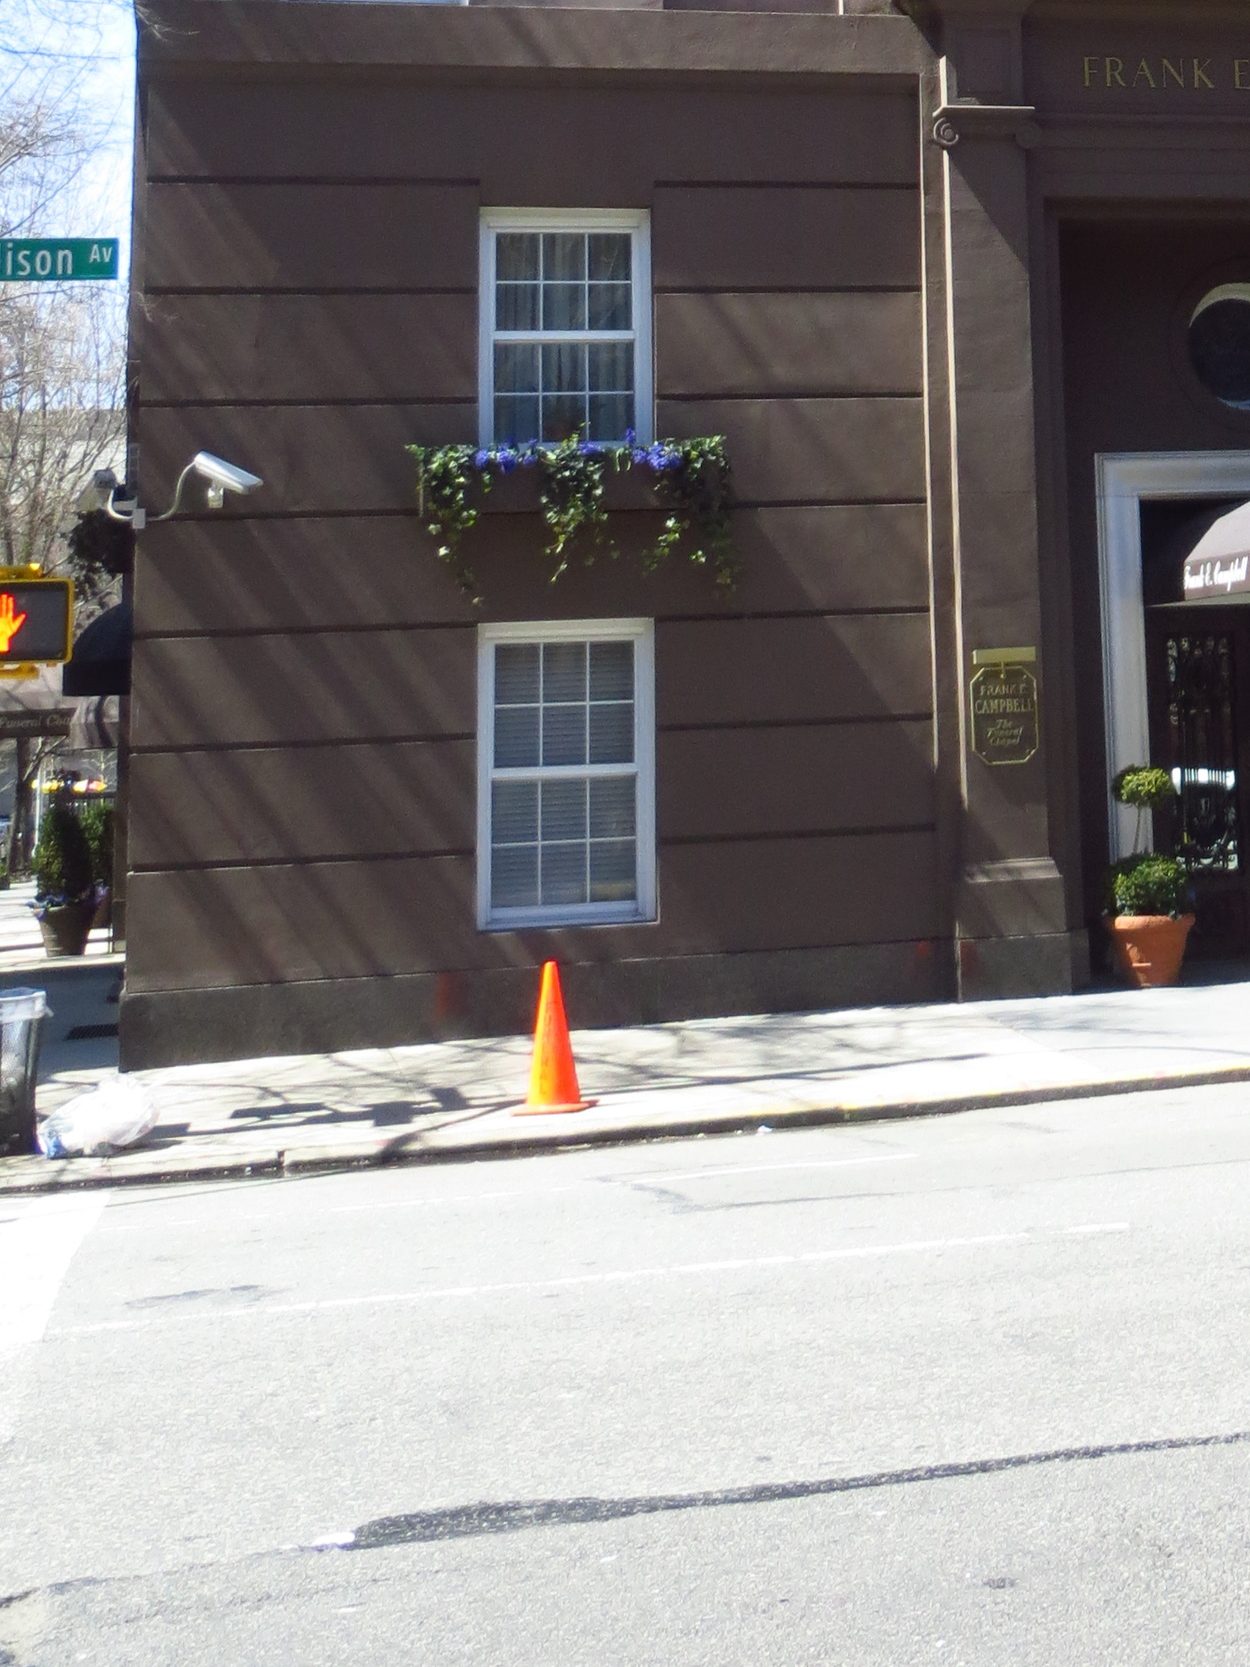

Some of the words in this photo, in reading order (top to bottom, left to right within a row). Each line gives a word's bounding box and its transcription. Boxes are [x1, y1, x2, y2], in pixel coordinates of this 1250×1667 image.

[1083, 56, 1214, 89] FRANK
[89, 243, 113, 264] Av
[980, 685, 1015, 695] FRANK
[975, 699, 1033, 713] CAMPBELL
